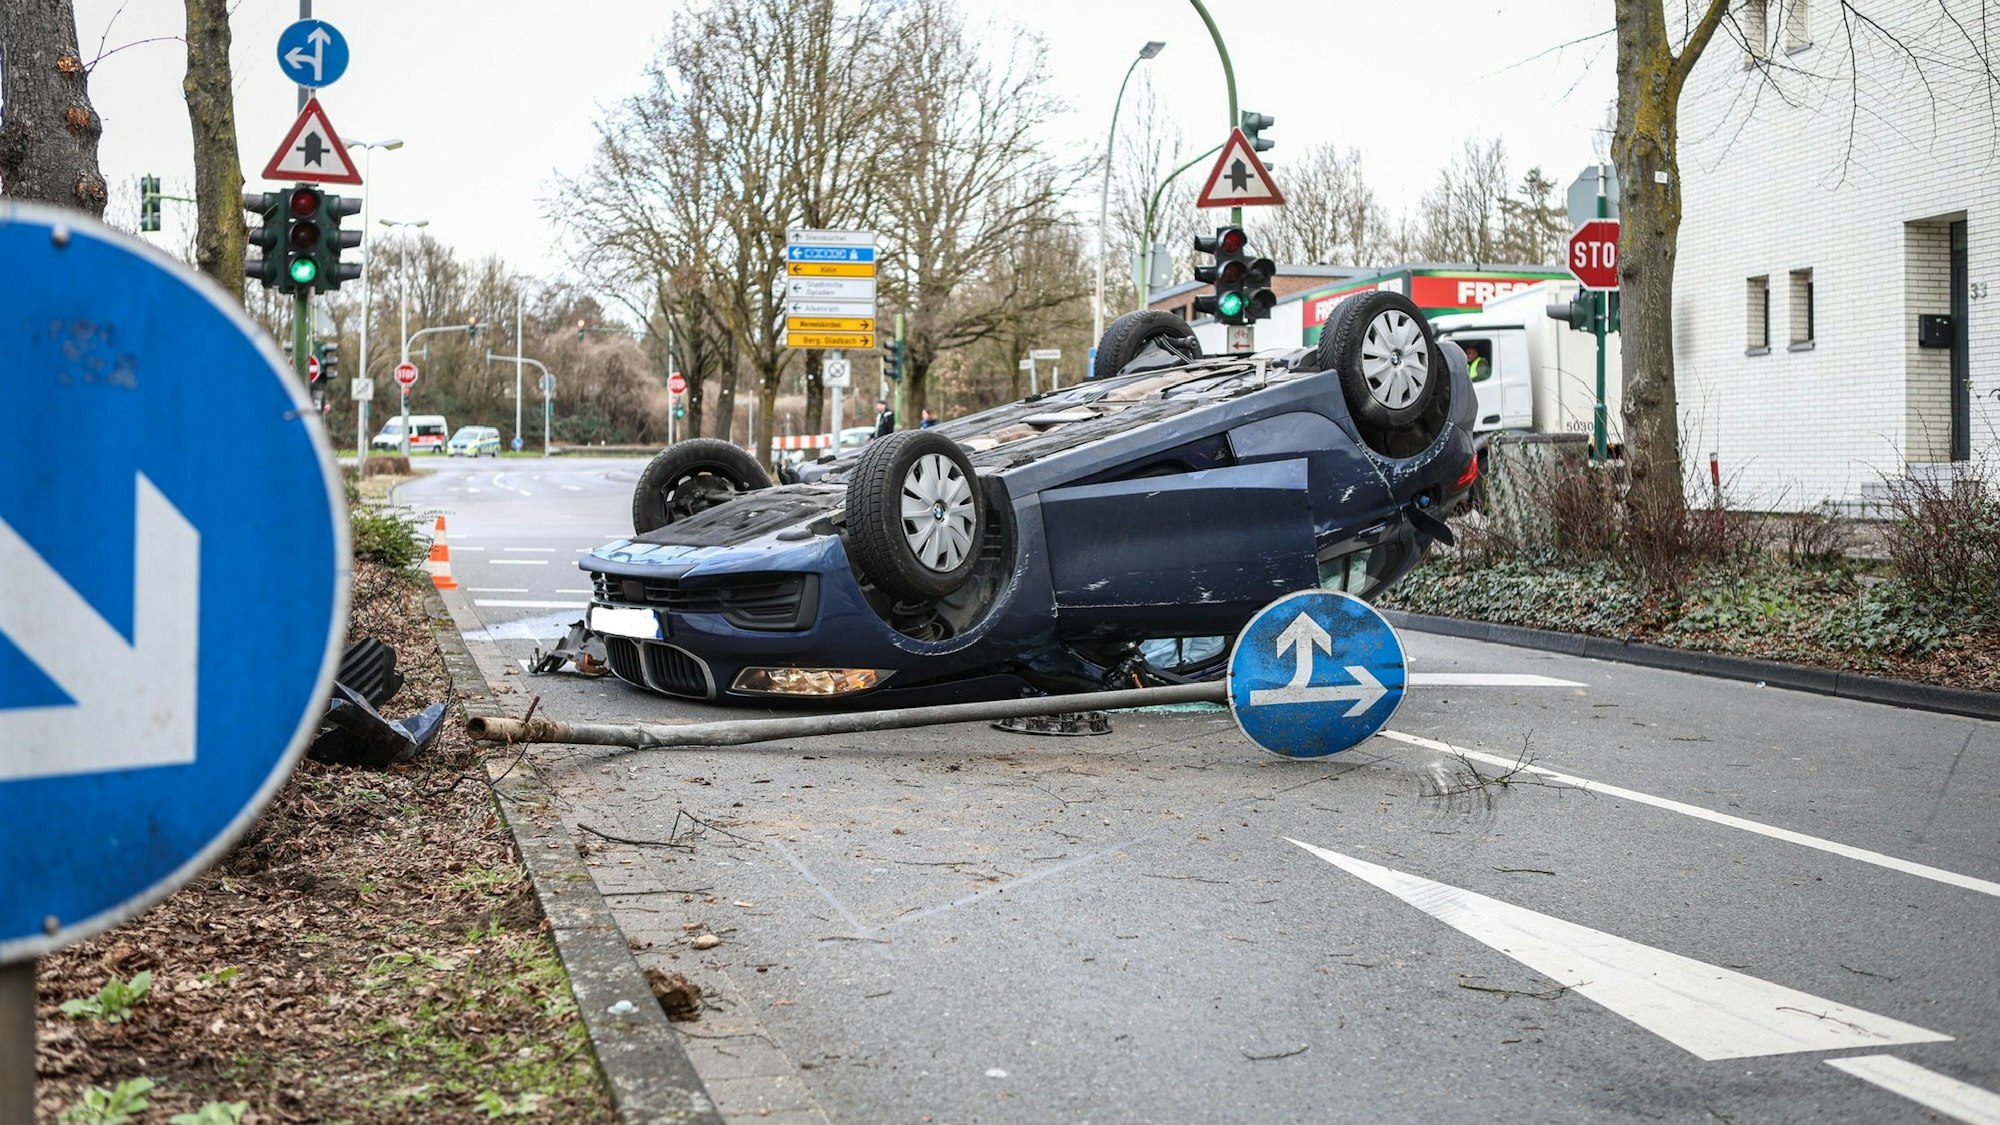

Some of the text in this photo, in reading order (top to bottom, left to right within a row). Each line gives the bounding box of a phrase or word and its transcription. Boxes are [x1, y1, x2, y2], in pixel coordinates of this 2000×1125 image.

[1574, 242, 1615, 268] STO
[820, 265, 837, 273] Köln
[1970, 282, 1987, 299] 33
[824, 336, 857, 345] Gladbach
[396, 369, 416, 378] STOP
